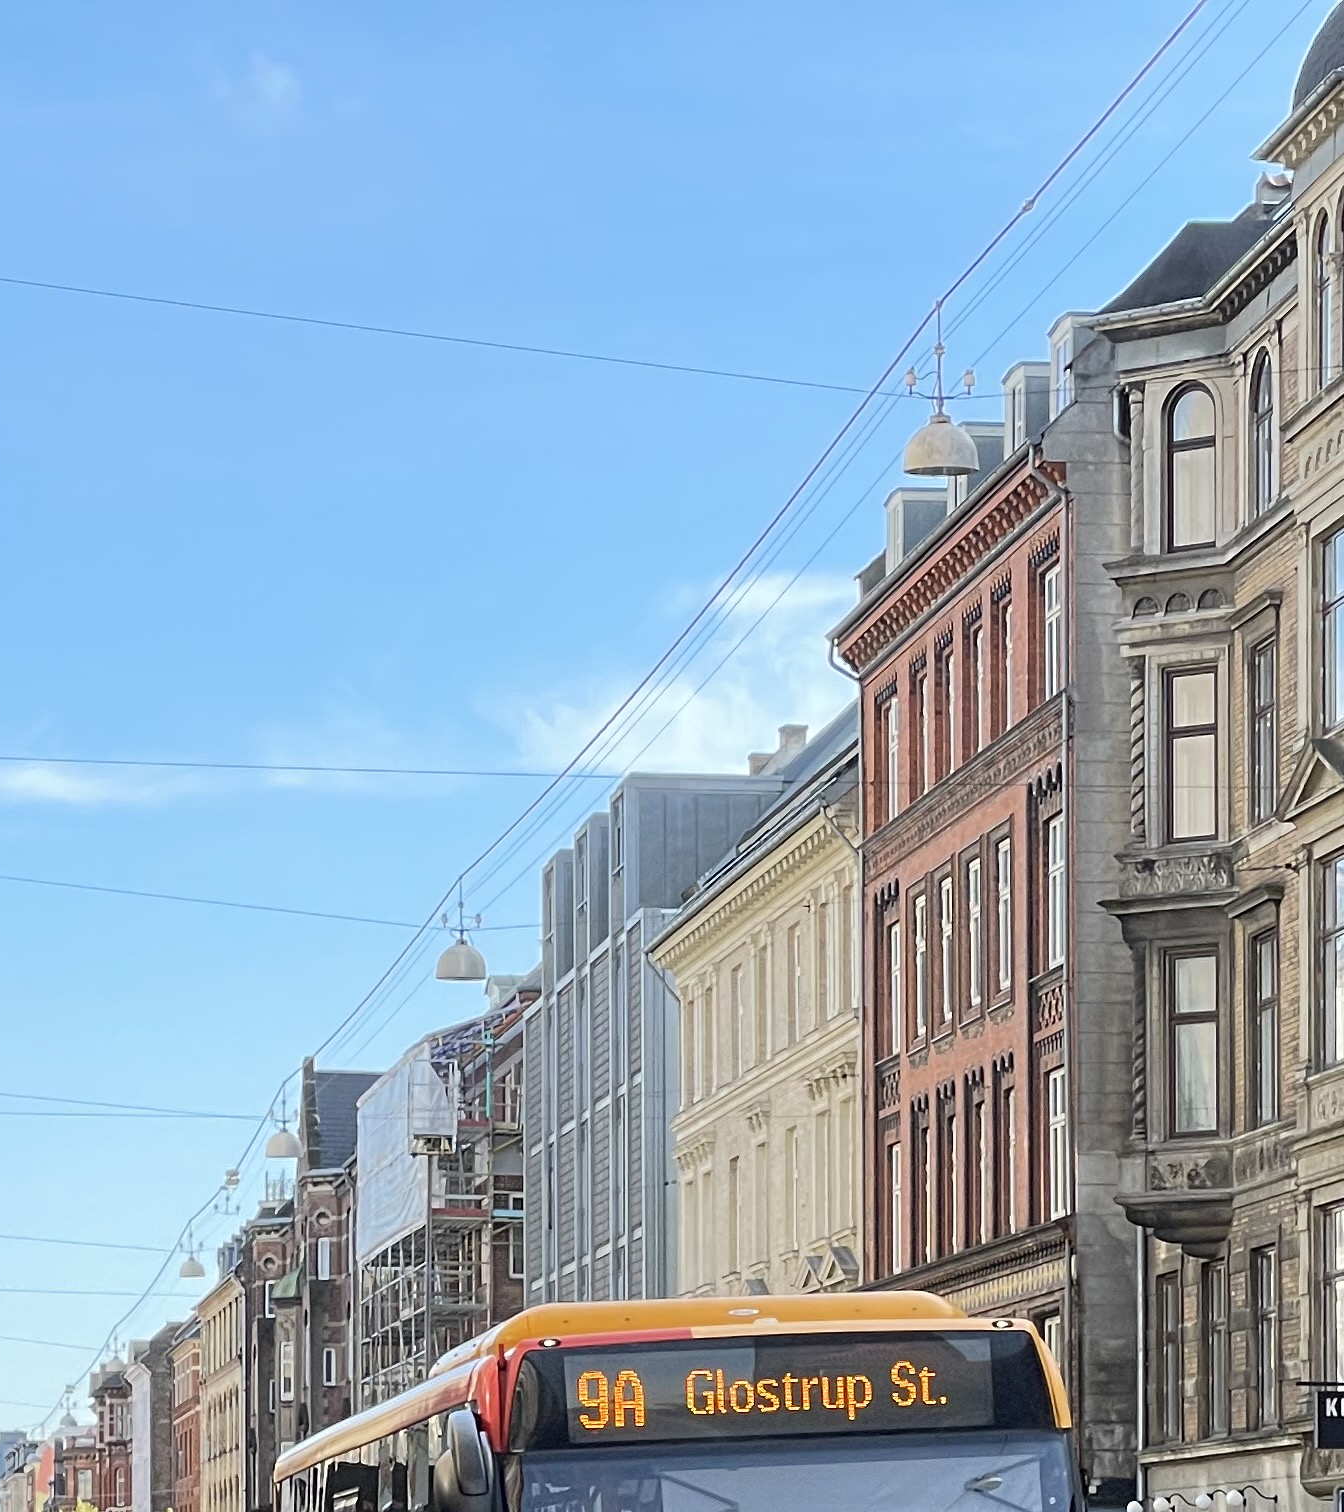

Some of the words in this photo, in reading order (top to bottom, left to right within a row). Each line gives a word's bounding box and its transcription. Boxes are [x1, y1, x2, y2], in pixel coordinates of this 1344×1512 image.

[577, 1369, 646, 1430] 9A
[686, 1368, 873, 1421] Glostrup
[890, 1360, 948, 1407] St.
